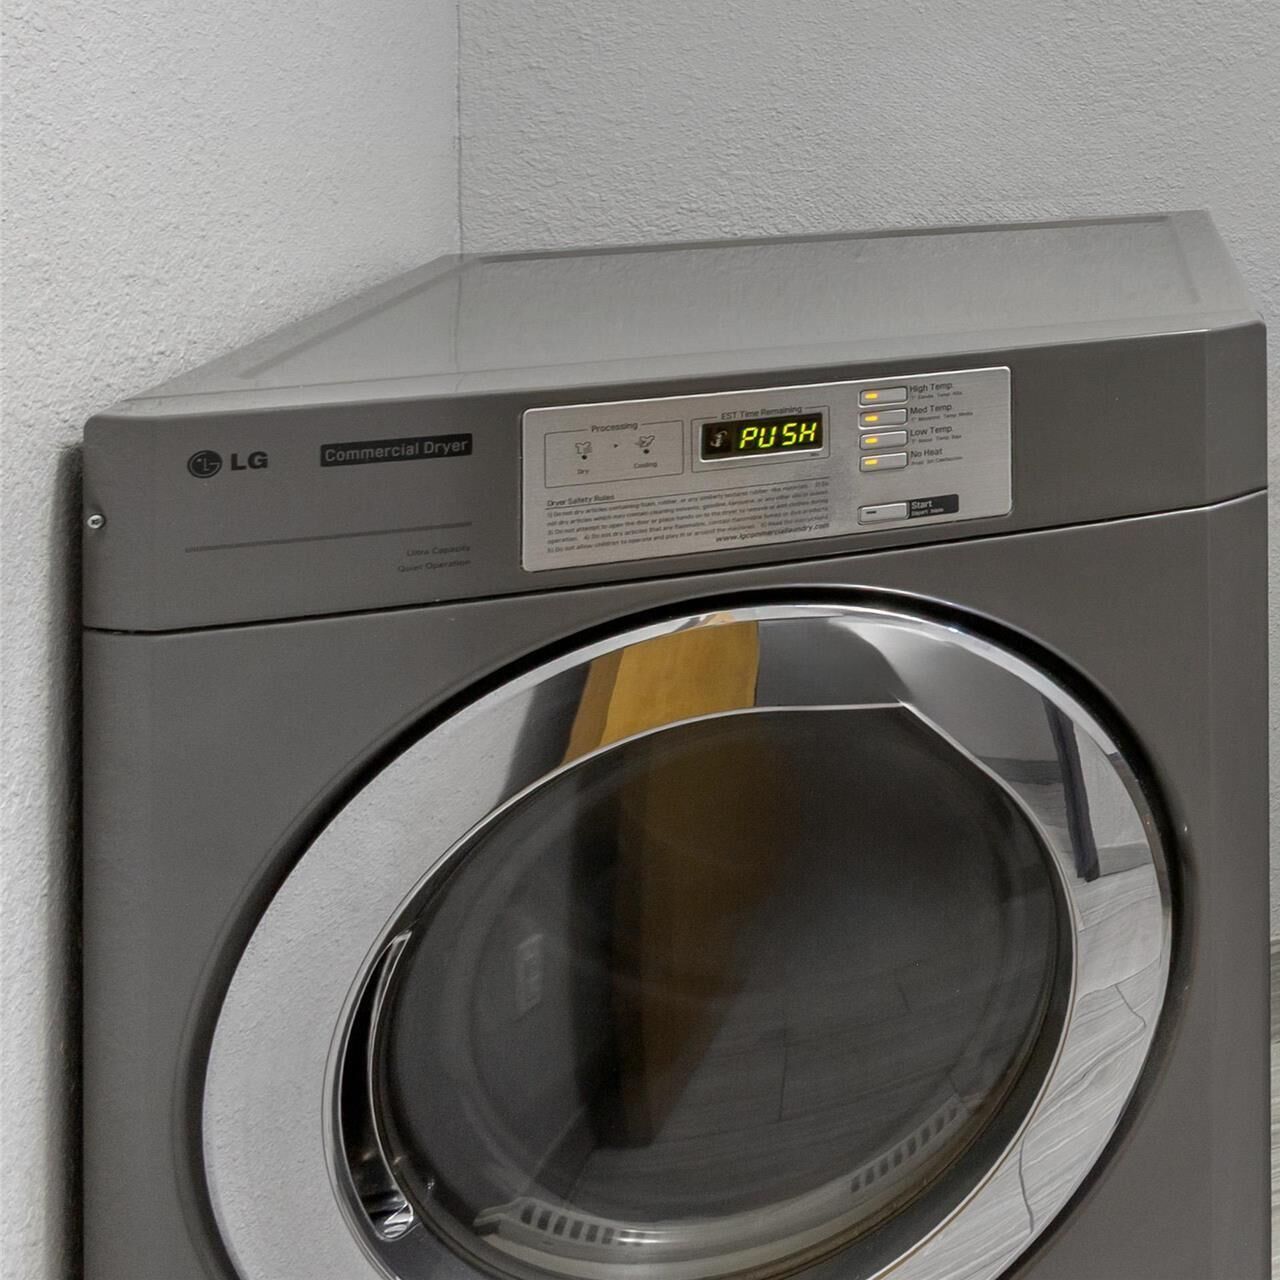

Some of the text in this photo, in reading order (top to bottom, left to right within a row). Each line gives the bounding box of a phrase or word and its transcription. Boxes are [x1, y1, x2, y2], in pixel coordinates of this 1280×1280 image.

[930, 382, 953, 391] Temp
[721, 406, 803, 420] EST Time Remaining
[930, 403, 953, 412] Temp
[590, 422, 639, 433] Processing
[930, 425, 953, 434] Temp
[738, 421, 818, 450] PUSH
[324, 438, 469, 463] Commercial Dryer
[230, 450, 269, 471] LG
[911, 500, 933, 510] Start
